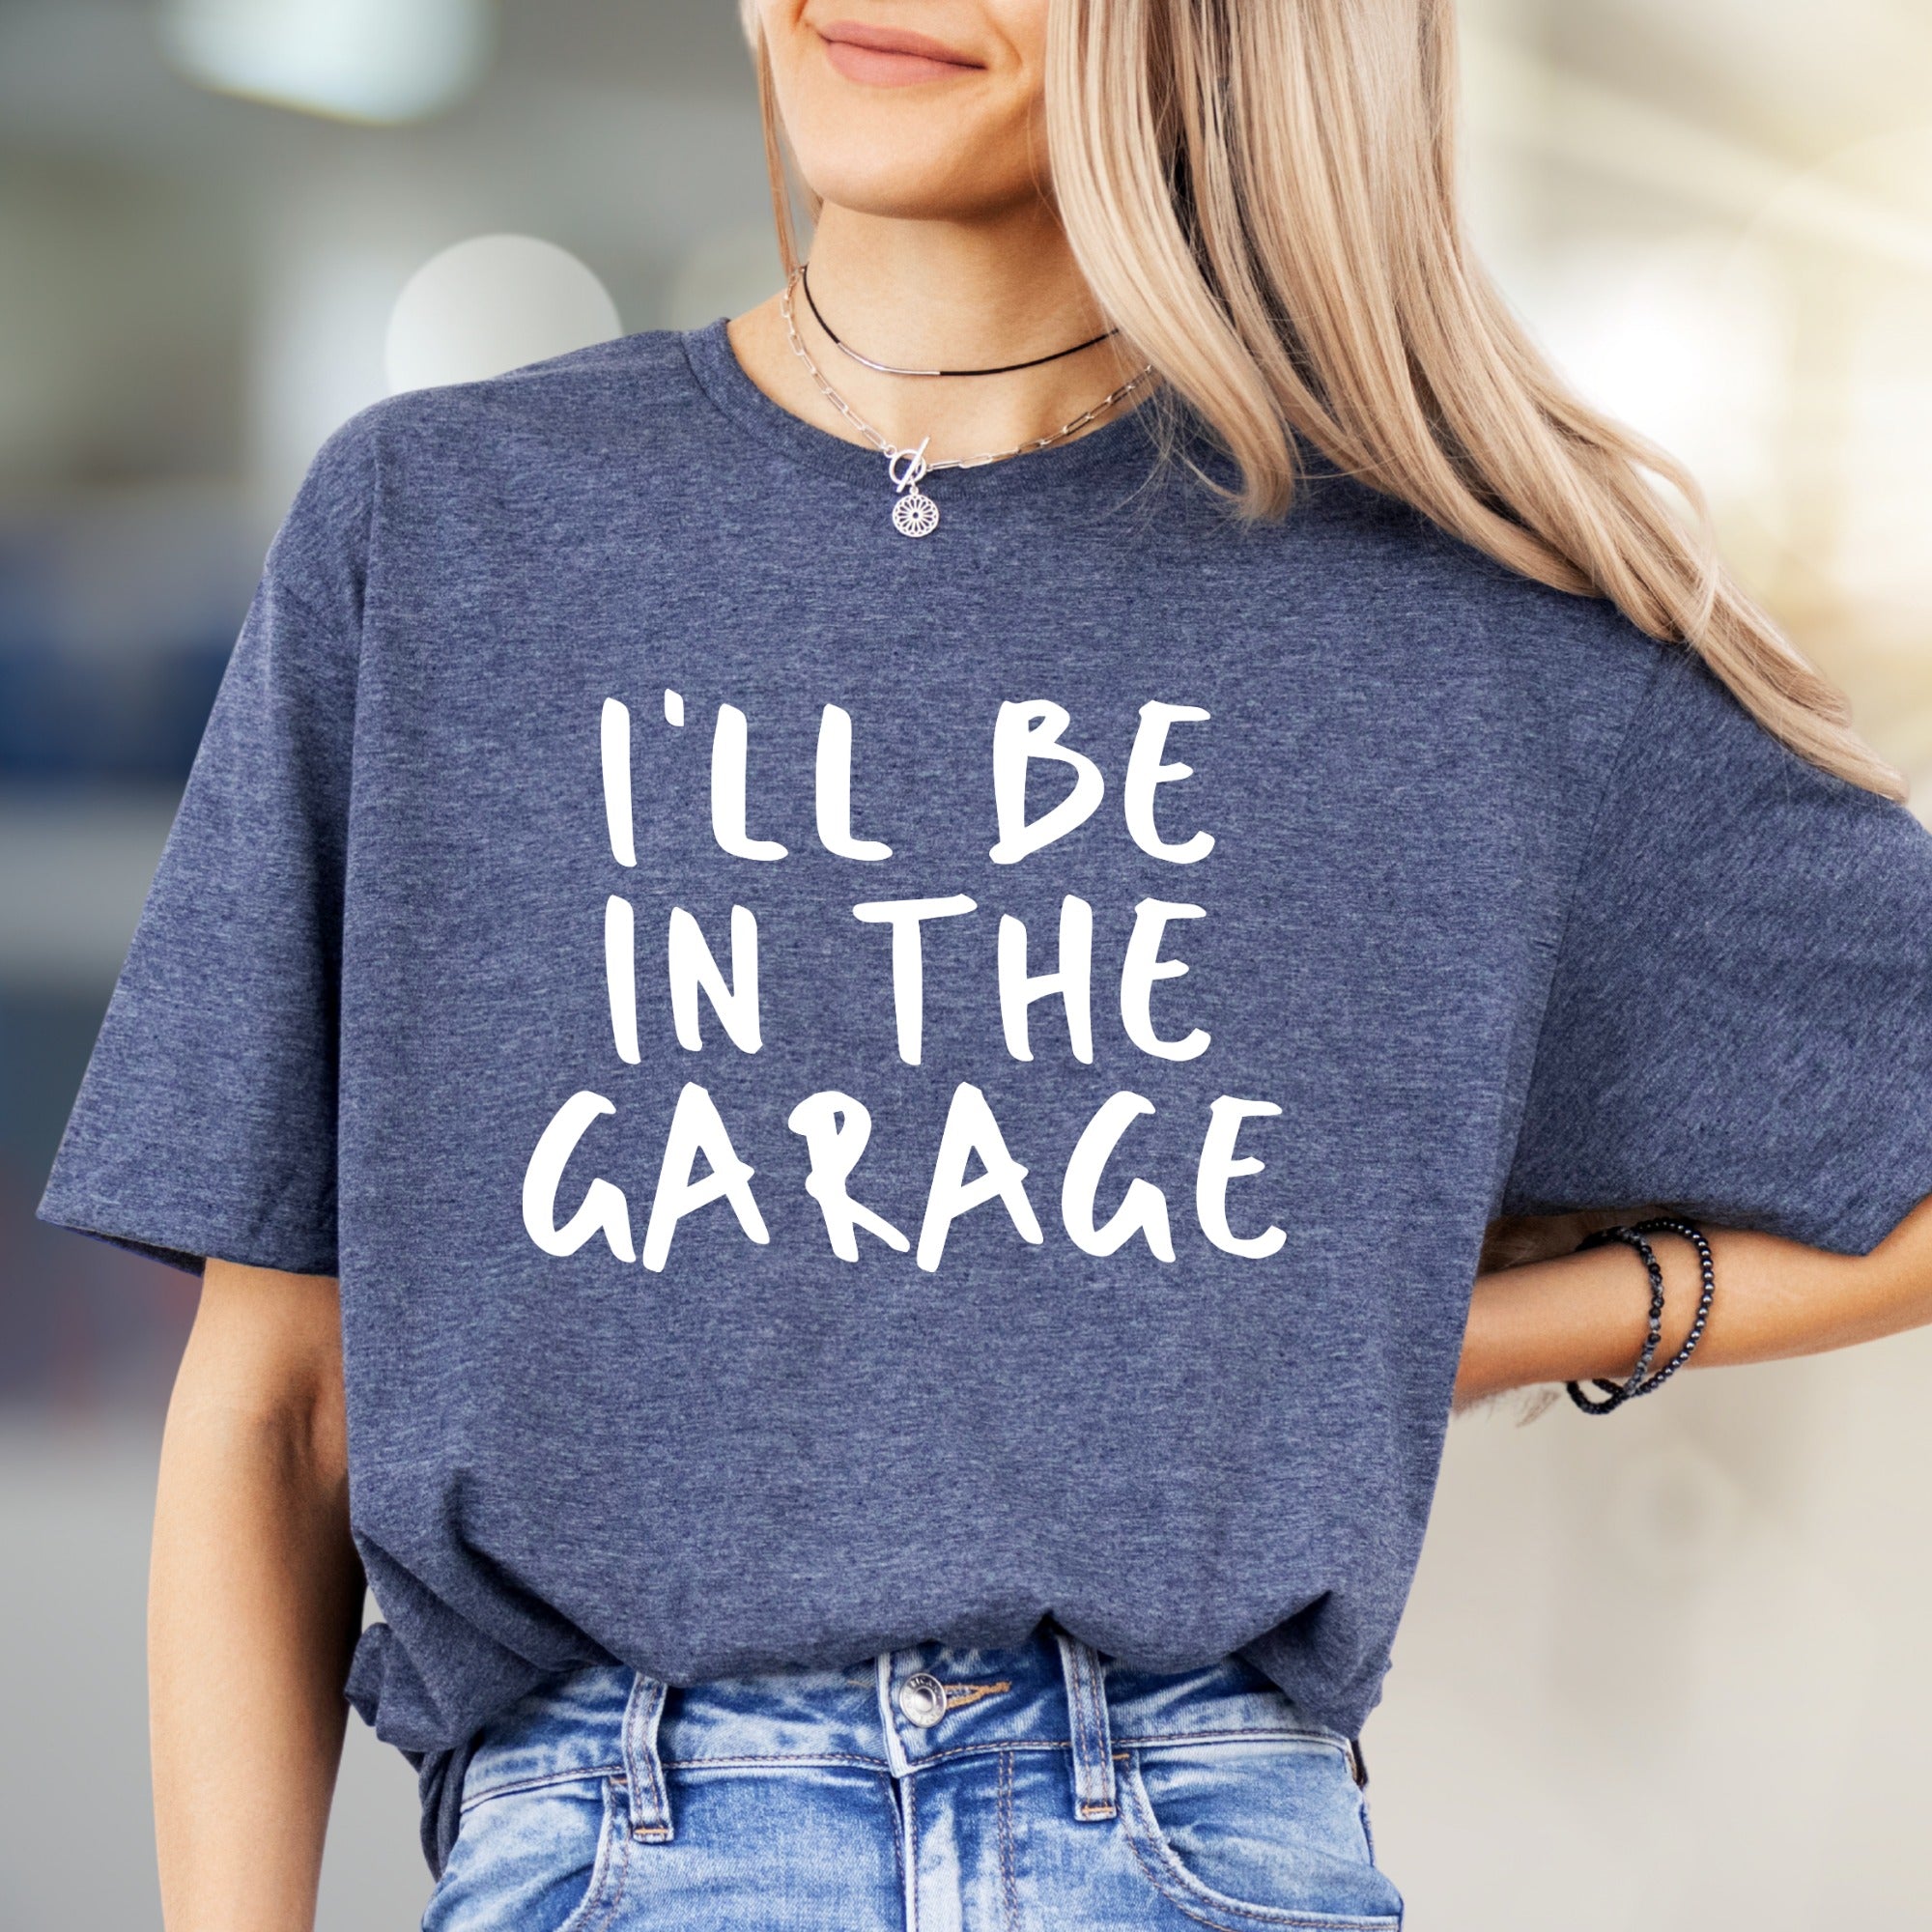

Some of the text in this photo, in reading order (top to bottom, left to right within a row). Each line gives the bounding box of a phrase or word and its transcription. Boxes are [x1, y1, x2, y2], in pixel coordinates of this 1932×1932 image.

[600, 688, 1215, 867] I'LL BE
[605, 894, 1211, 1065] IN THE
[522, 1081, 1287, 1273] GARAGE
